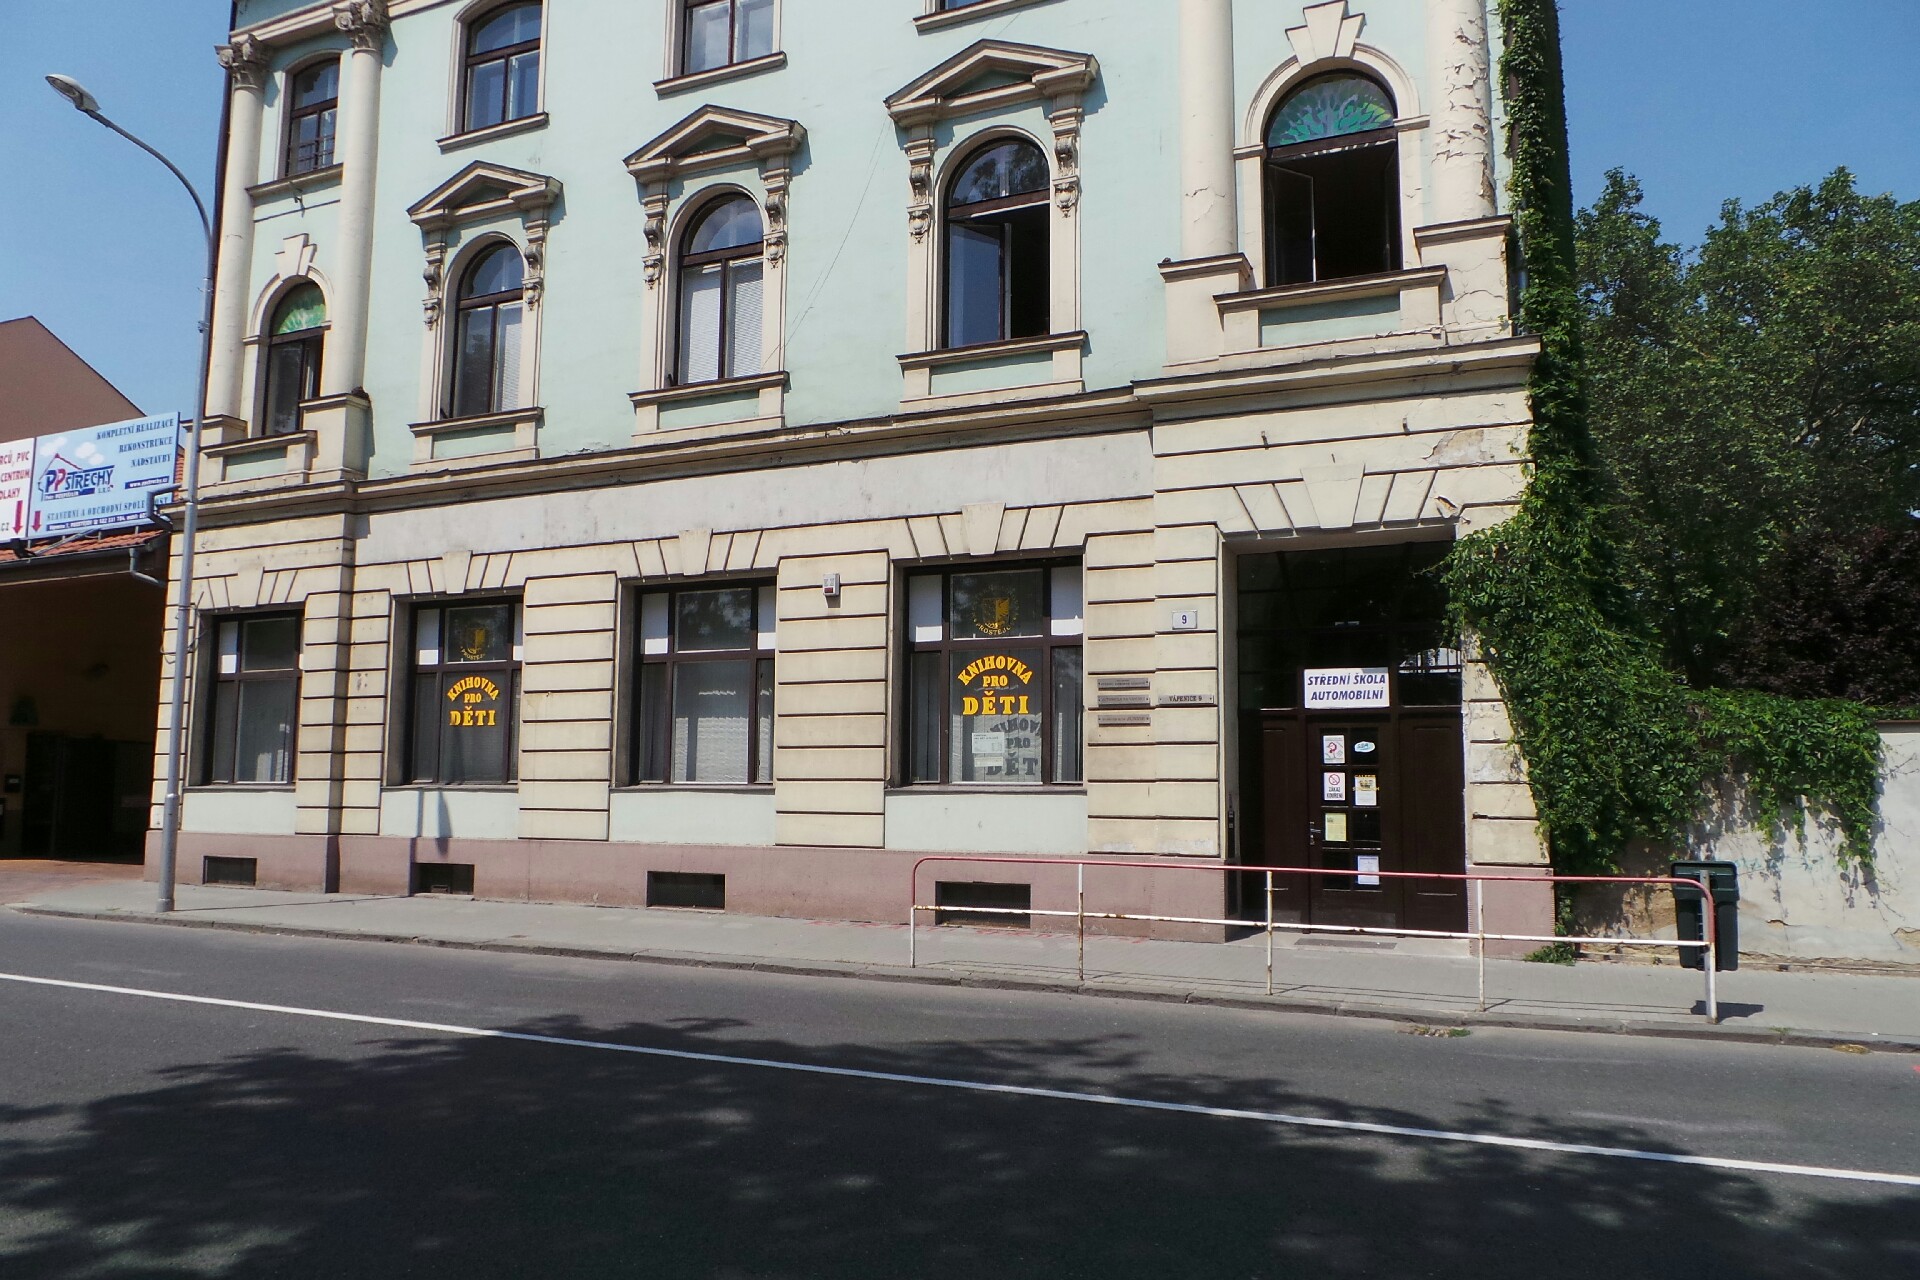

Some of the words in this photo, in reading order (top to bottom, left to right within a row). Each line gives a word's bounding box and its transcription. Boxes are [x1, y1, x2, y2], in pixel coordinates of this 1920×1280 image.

[97, 424, 135, 440] KOMPLETNÍ
[136, 418, 174, 433] REALIZACE
[119, 436, 173, 453] REKONSTRUKCE
[131, 453, 171, 468] NADSTAVBY
[1, 469, 31, 482] CENTRUM
[1181, 614, 1188, 625] 9
[957, 655, 1033, 686] KNIHOVNA
[982, 674, 1008, 687] PRO
[1307, 672, 1351, 686] STŘEDNÍ
[1353, 672, 1386, 685] ŠKOLA
[447, 676, 499, 702] KNIHOVNA
[1311, 686, 1383, 701] AUTOMOBILNÍ
[464, 692, 482, 703] PRO
[962, 690, 1029, 715] DĚTI
[449, 705, 496, 726] DĚTI
